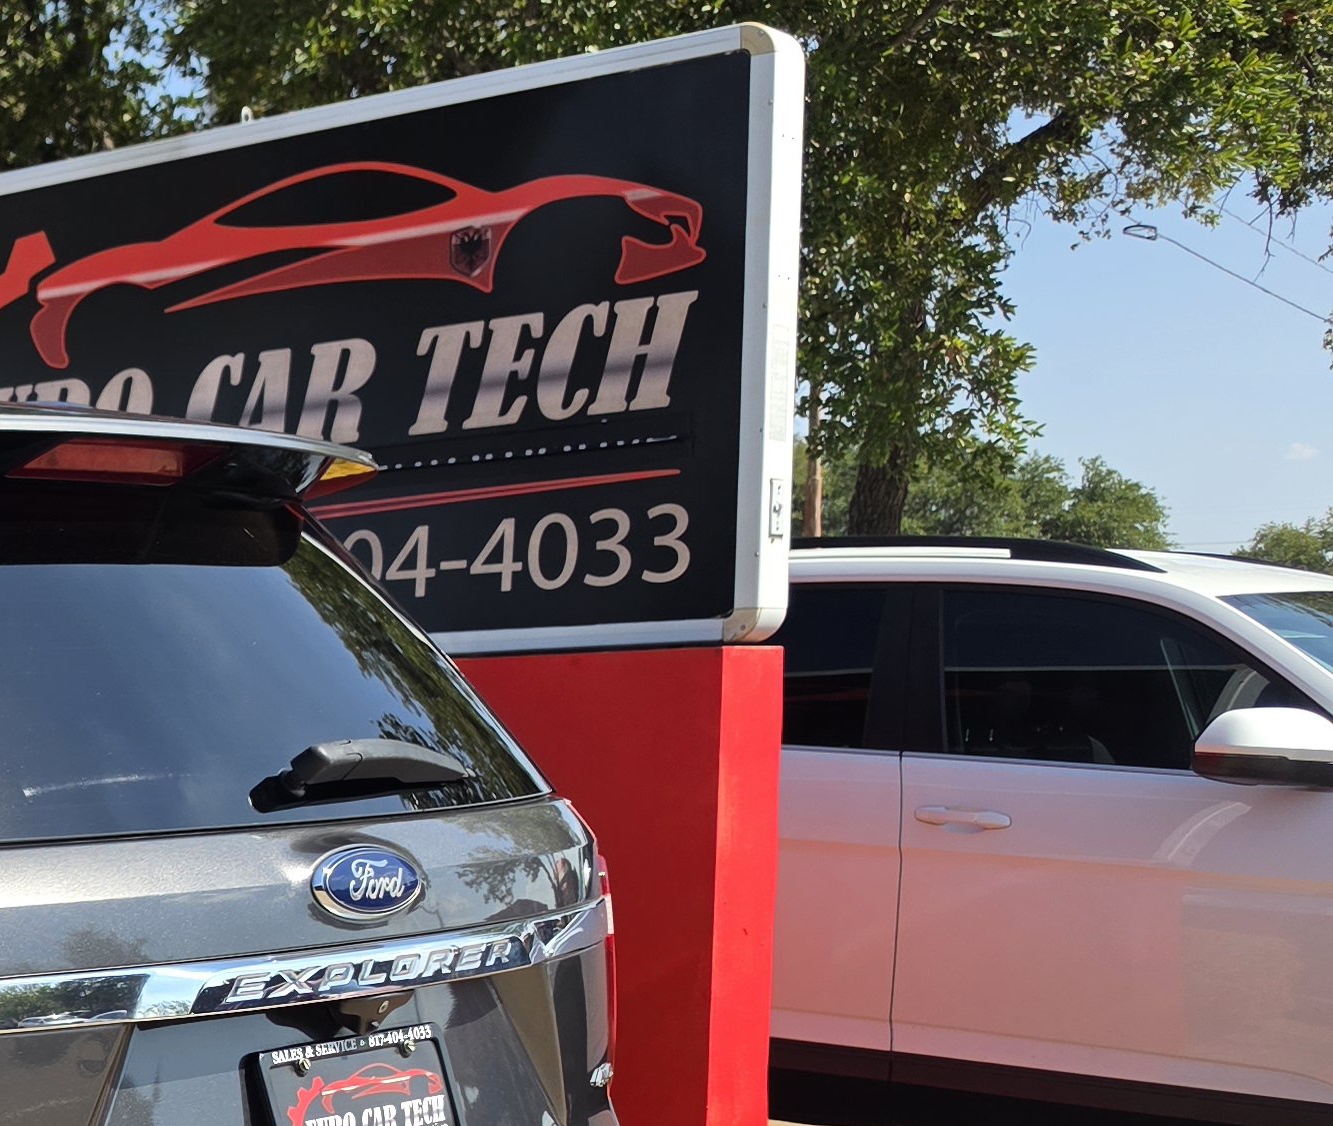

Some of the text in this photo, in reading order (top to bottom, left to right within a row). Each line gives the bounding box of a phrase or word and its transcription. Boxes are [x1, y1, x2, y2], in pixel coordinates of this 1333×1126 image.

[185, 338, 377, 443] CAR
[408, 290, 699, 436] TECH
[349, 858, 406, 901] Ford
[224, 939, 513, 1003] EXPLORER
[271, 1024, 432, 1065] SALES & SERVICE 817-404-4033
